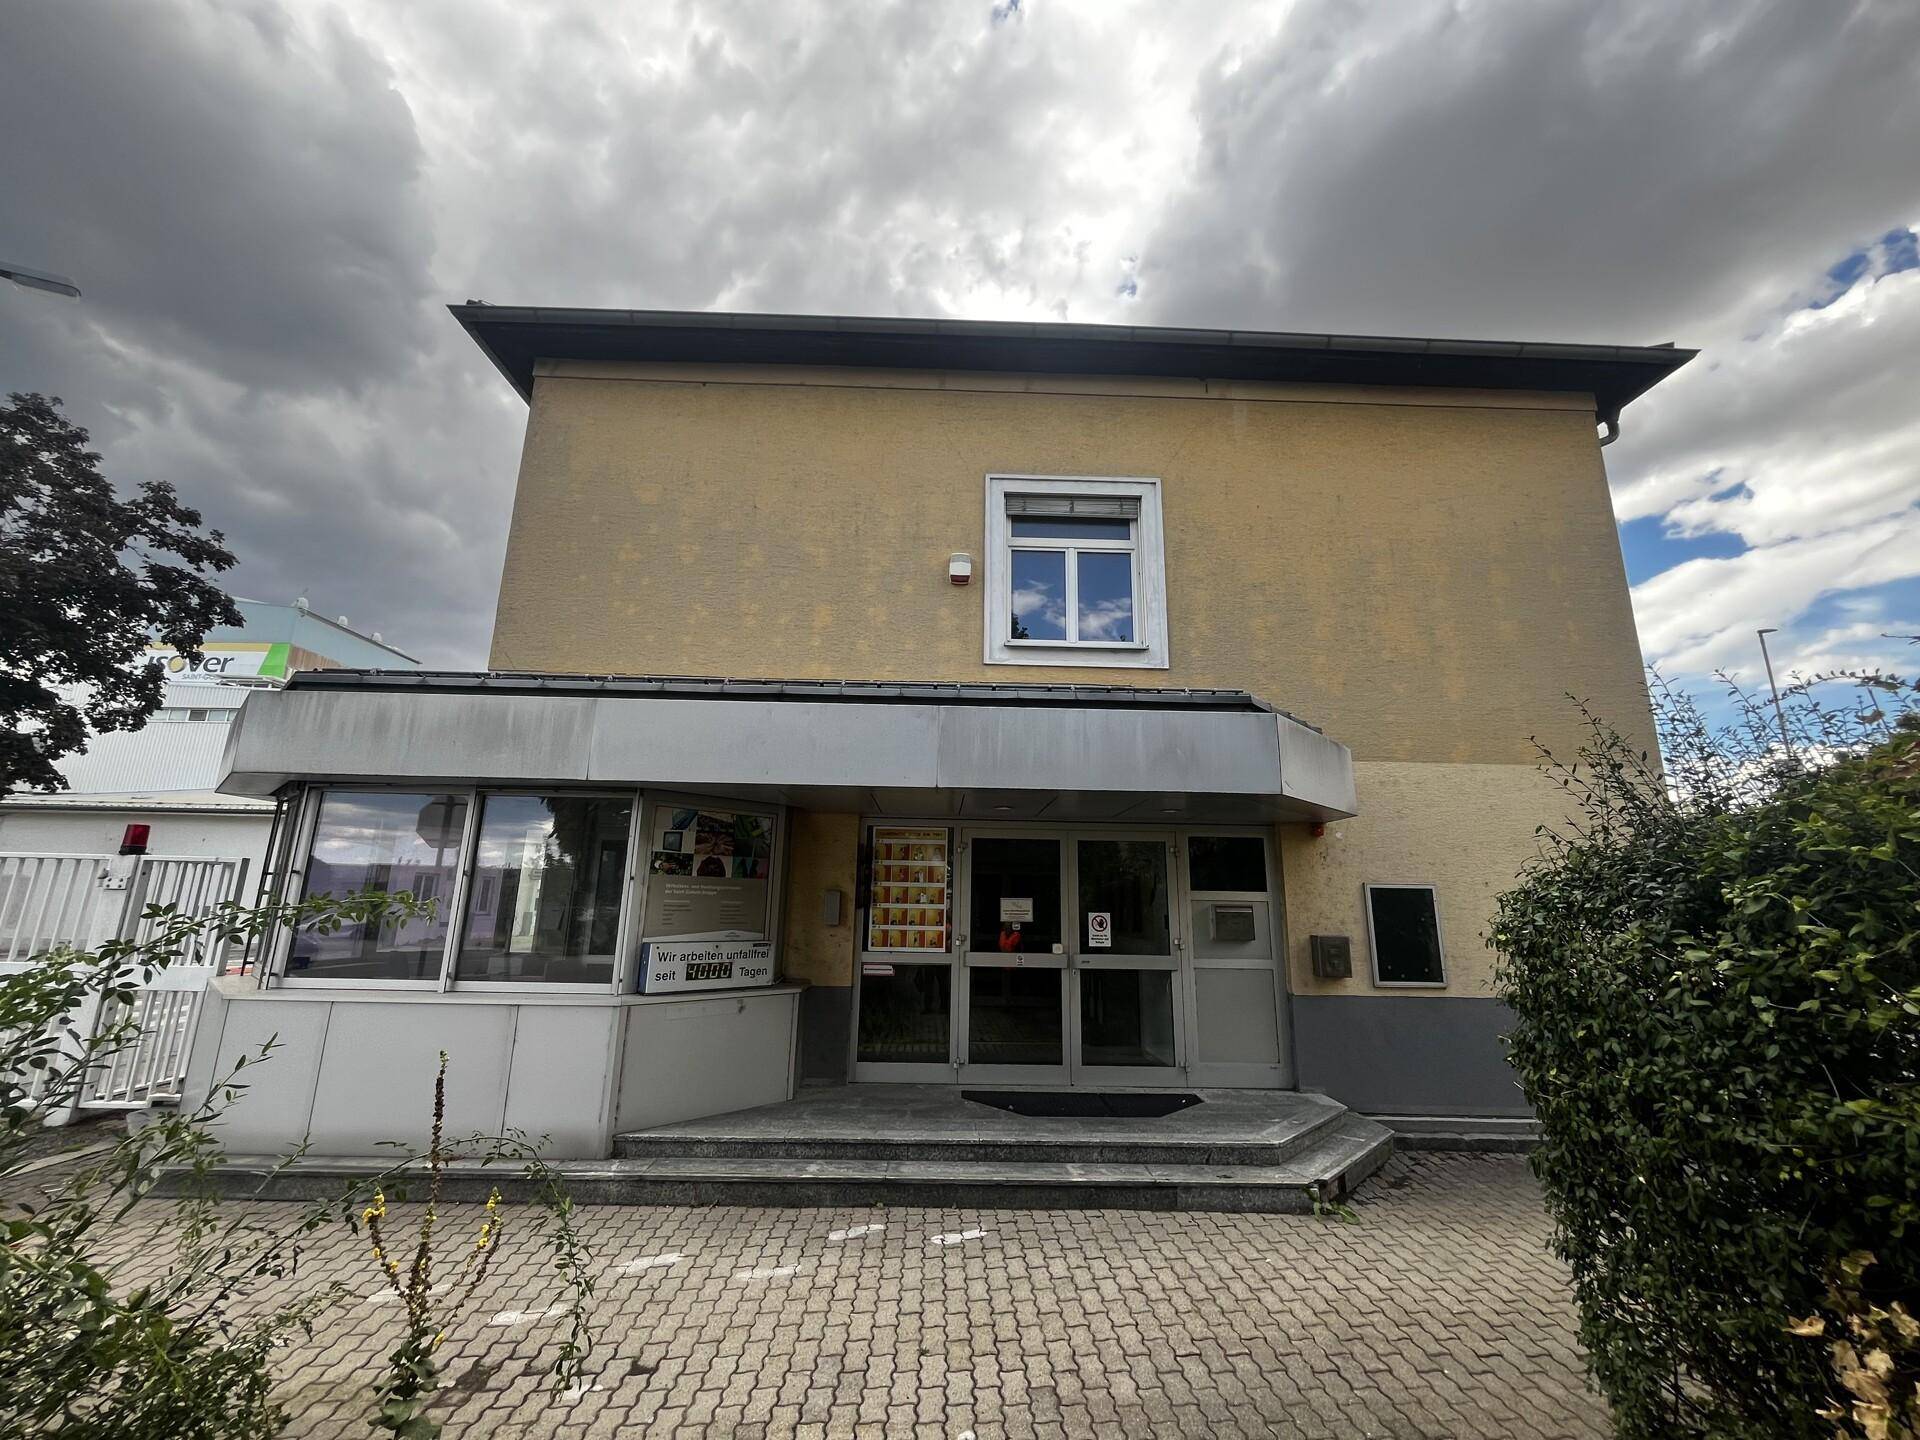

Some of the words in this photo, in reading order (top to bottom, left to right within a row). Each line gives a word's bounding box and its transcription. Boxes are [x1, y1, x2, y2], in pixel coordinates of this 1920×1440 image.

[658, 952, 677, 962] Wir
[680, 950, 723, 962] arbeiten
[726, 949, 769, 960] unfallfrei
[655, 970, 676, 982] seit
[687, 963, 731, 980] 4000
[739, 967, 768, 979] Tagen
